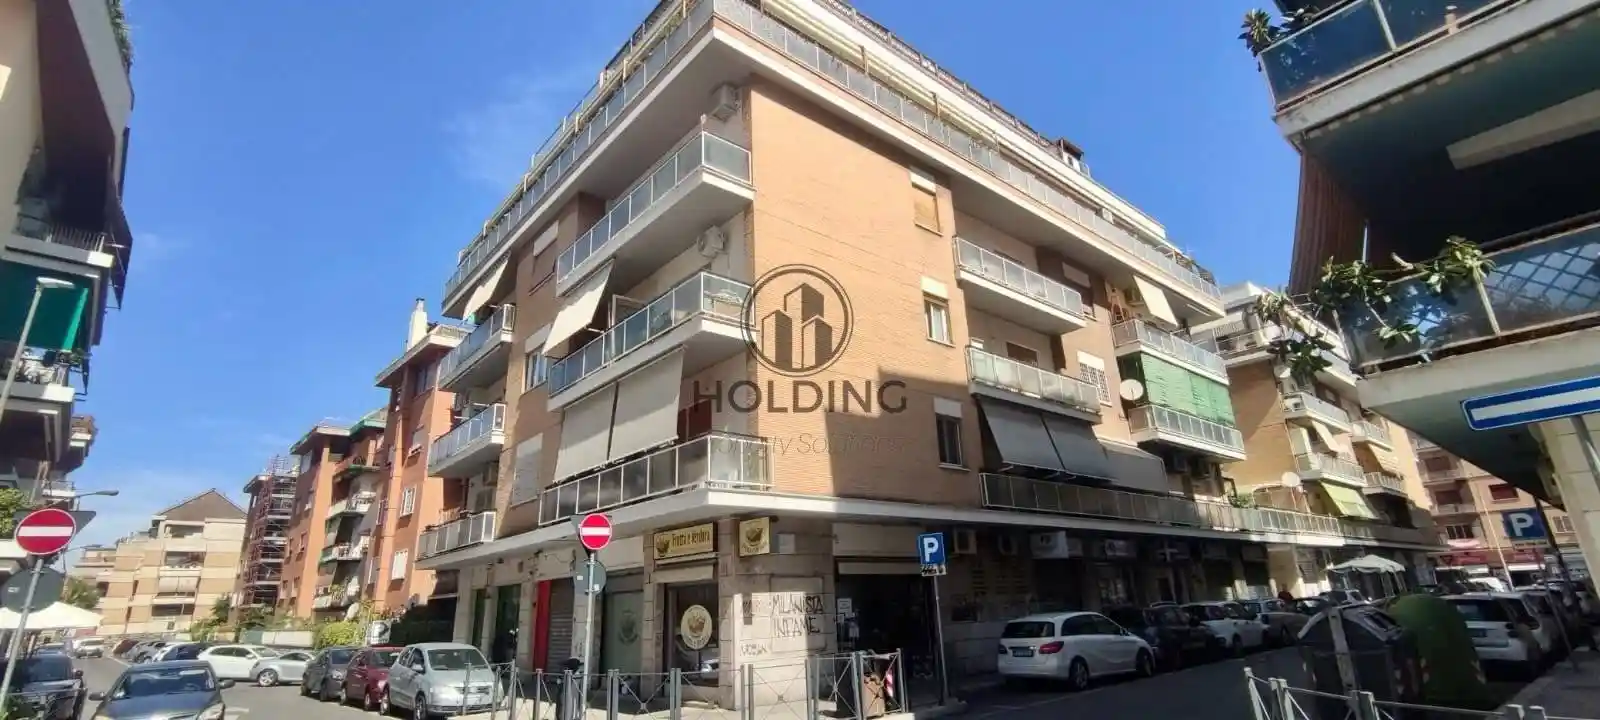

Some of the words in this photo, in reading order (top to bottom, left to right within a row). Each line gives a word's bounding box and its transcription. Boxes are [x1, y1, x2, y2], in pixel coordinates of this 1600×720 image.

[1510, 513, 1534, 537] P
[923, 537, 939, 562] P
[772, 593, 823, 615] MILANISTA
[773, 616, 820, 638] INFAME
